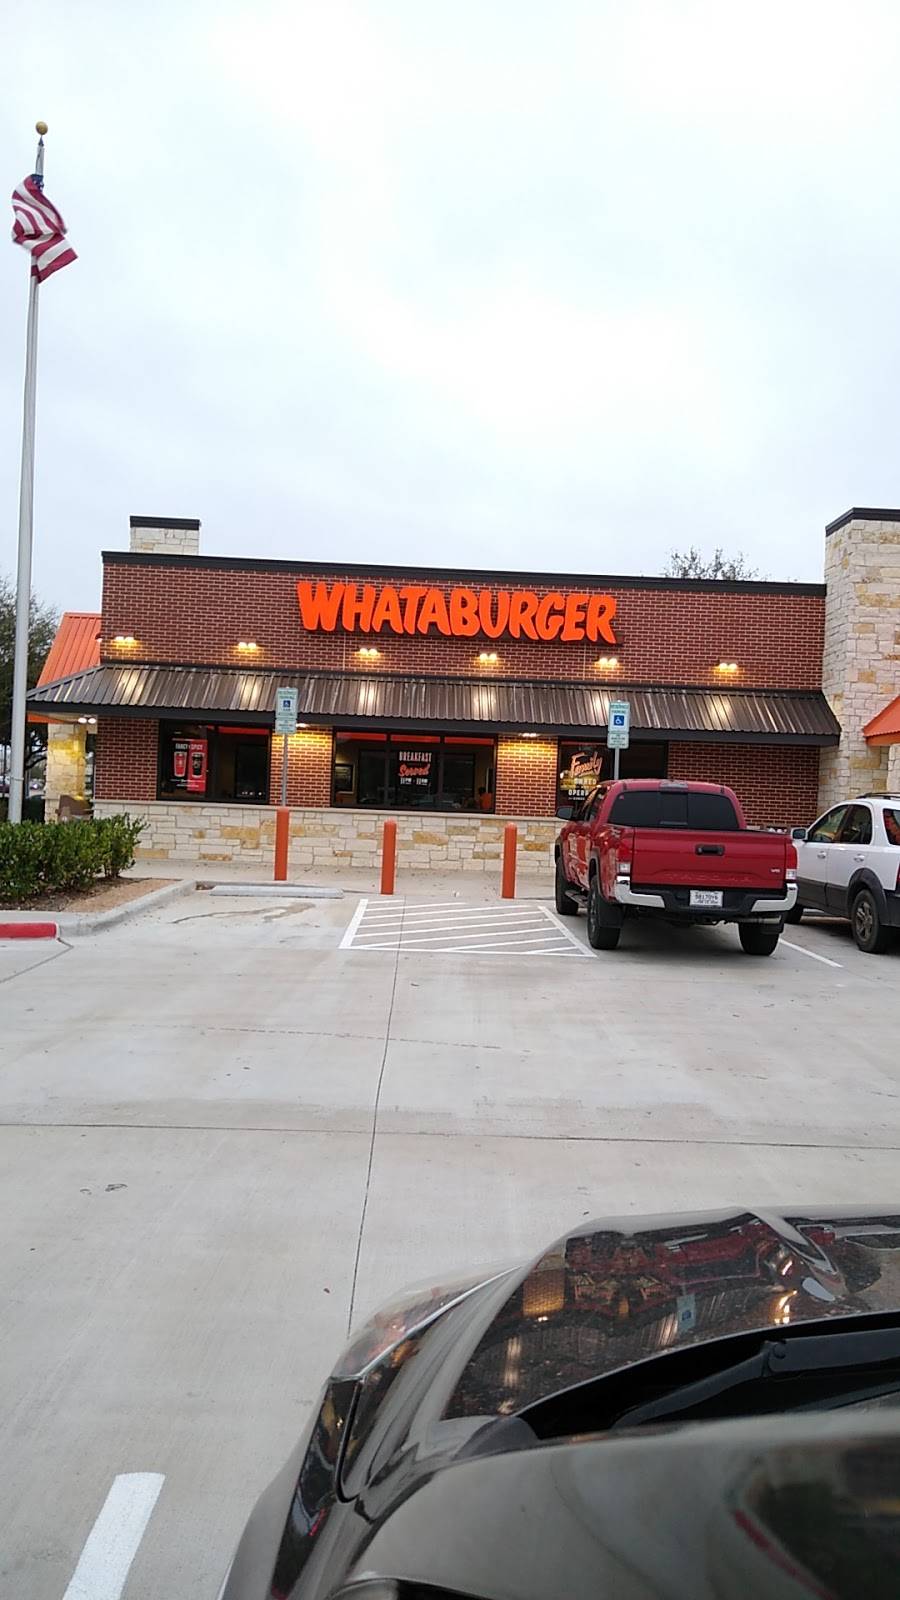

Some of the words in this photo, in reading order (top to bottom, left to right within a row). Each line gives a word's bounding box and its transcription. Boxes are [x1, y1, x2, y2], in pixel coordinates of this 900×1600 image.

[297, 581, 617, 644] WHATABURGER
[399, 751, 432, 762] BREAKFAST
[570, 751, 603, 778] Family
[398, 763, 430, 777] Served
